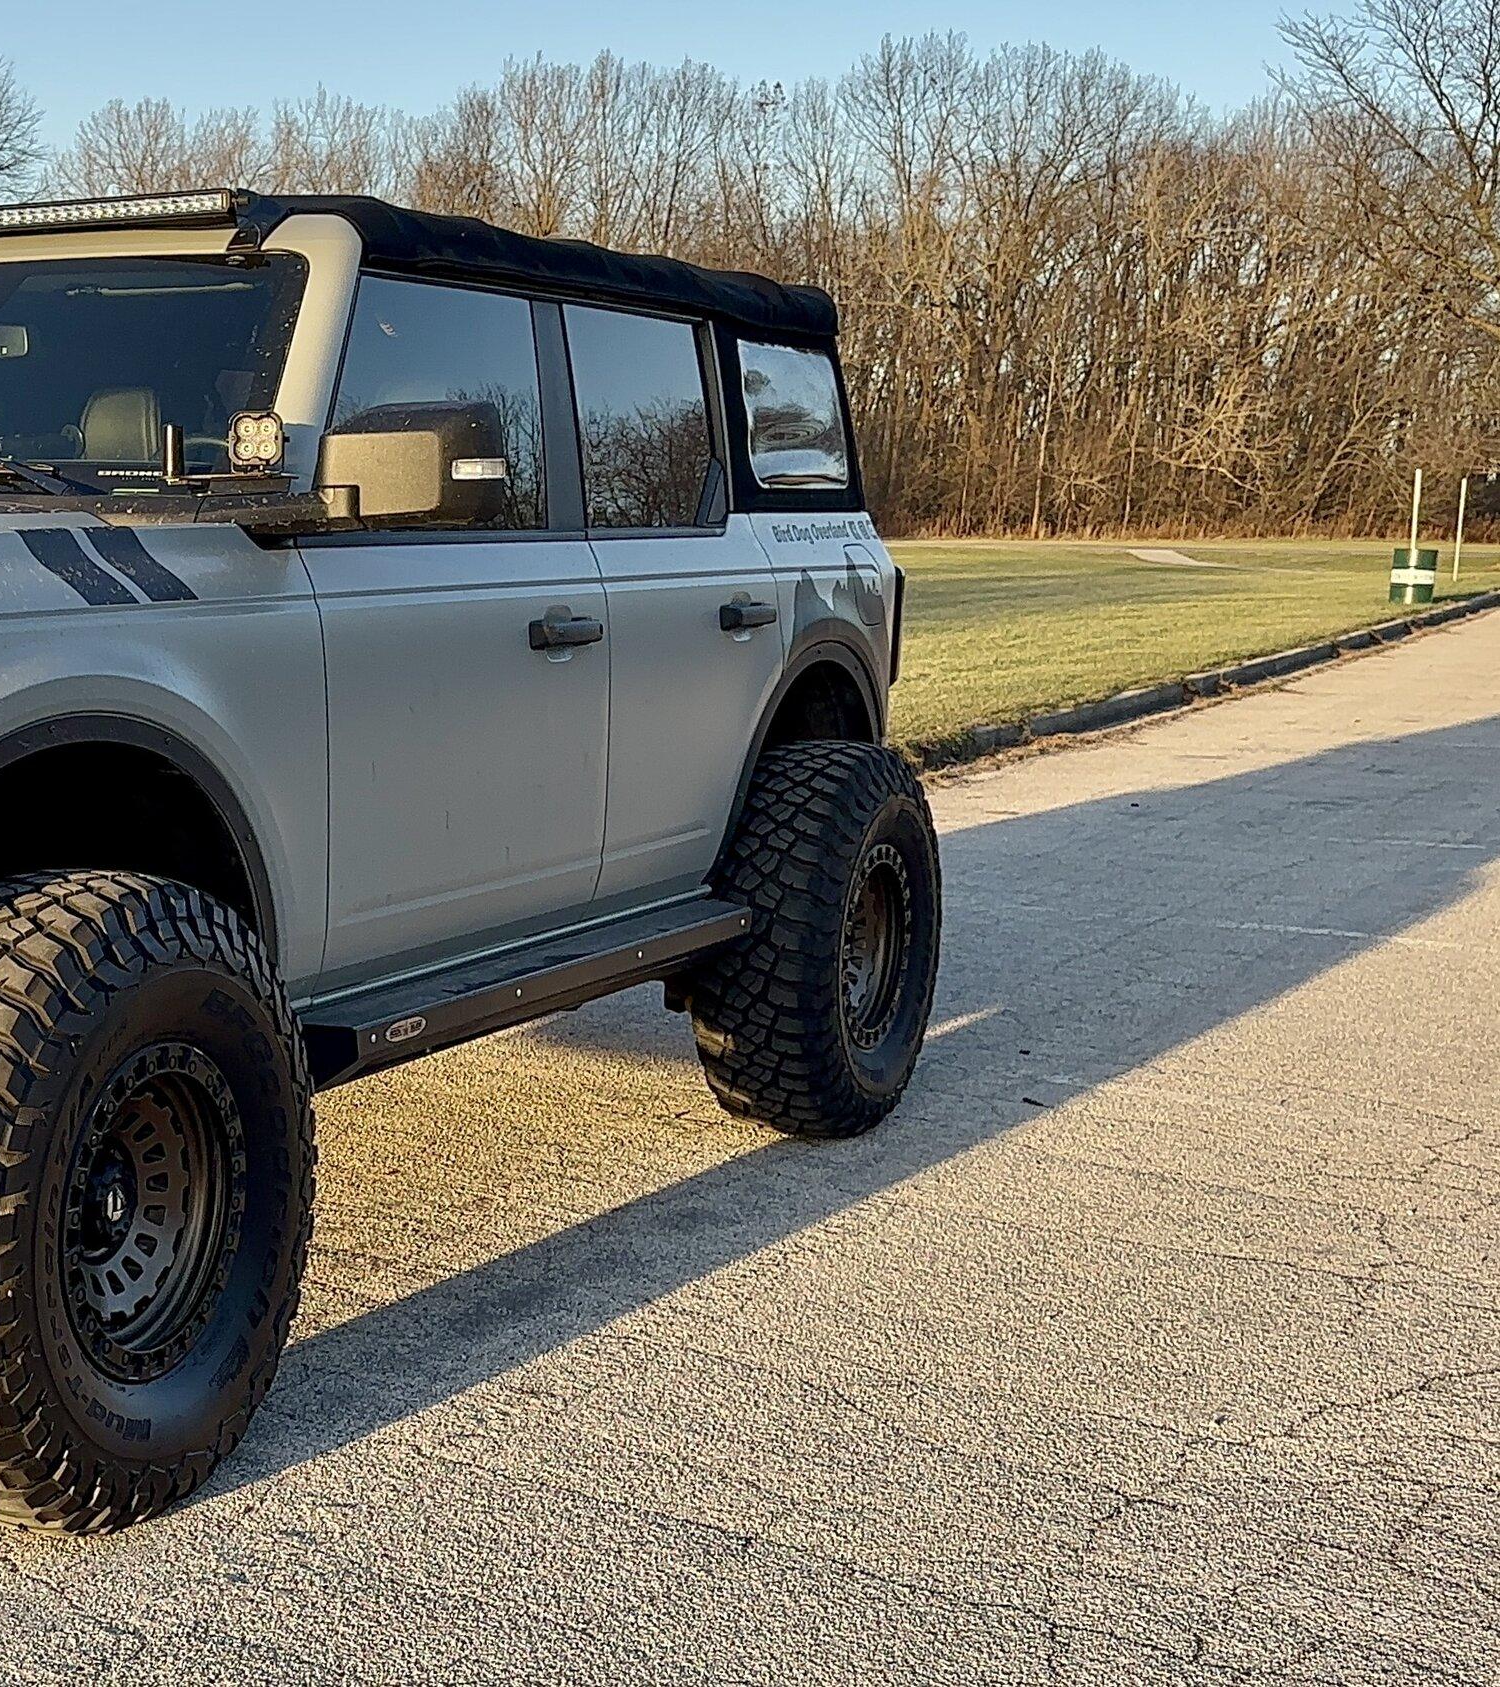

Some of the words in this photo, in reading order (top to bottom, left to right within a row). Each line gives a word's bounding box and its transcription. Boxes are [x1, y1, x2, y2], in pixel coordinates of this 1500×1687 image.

[772, 524, 794, 543] Bird
[793, 524, 815, 544] Dog
[811, 520, 850, 541] Overland
